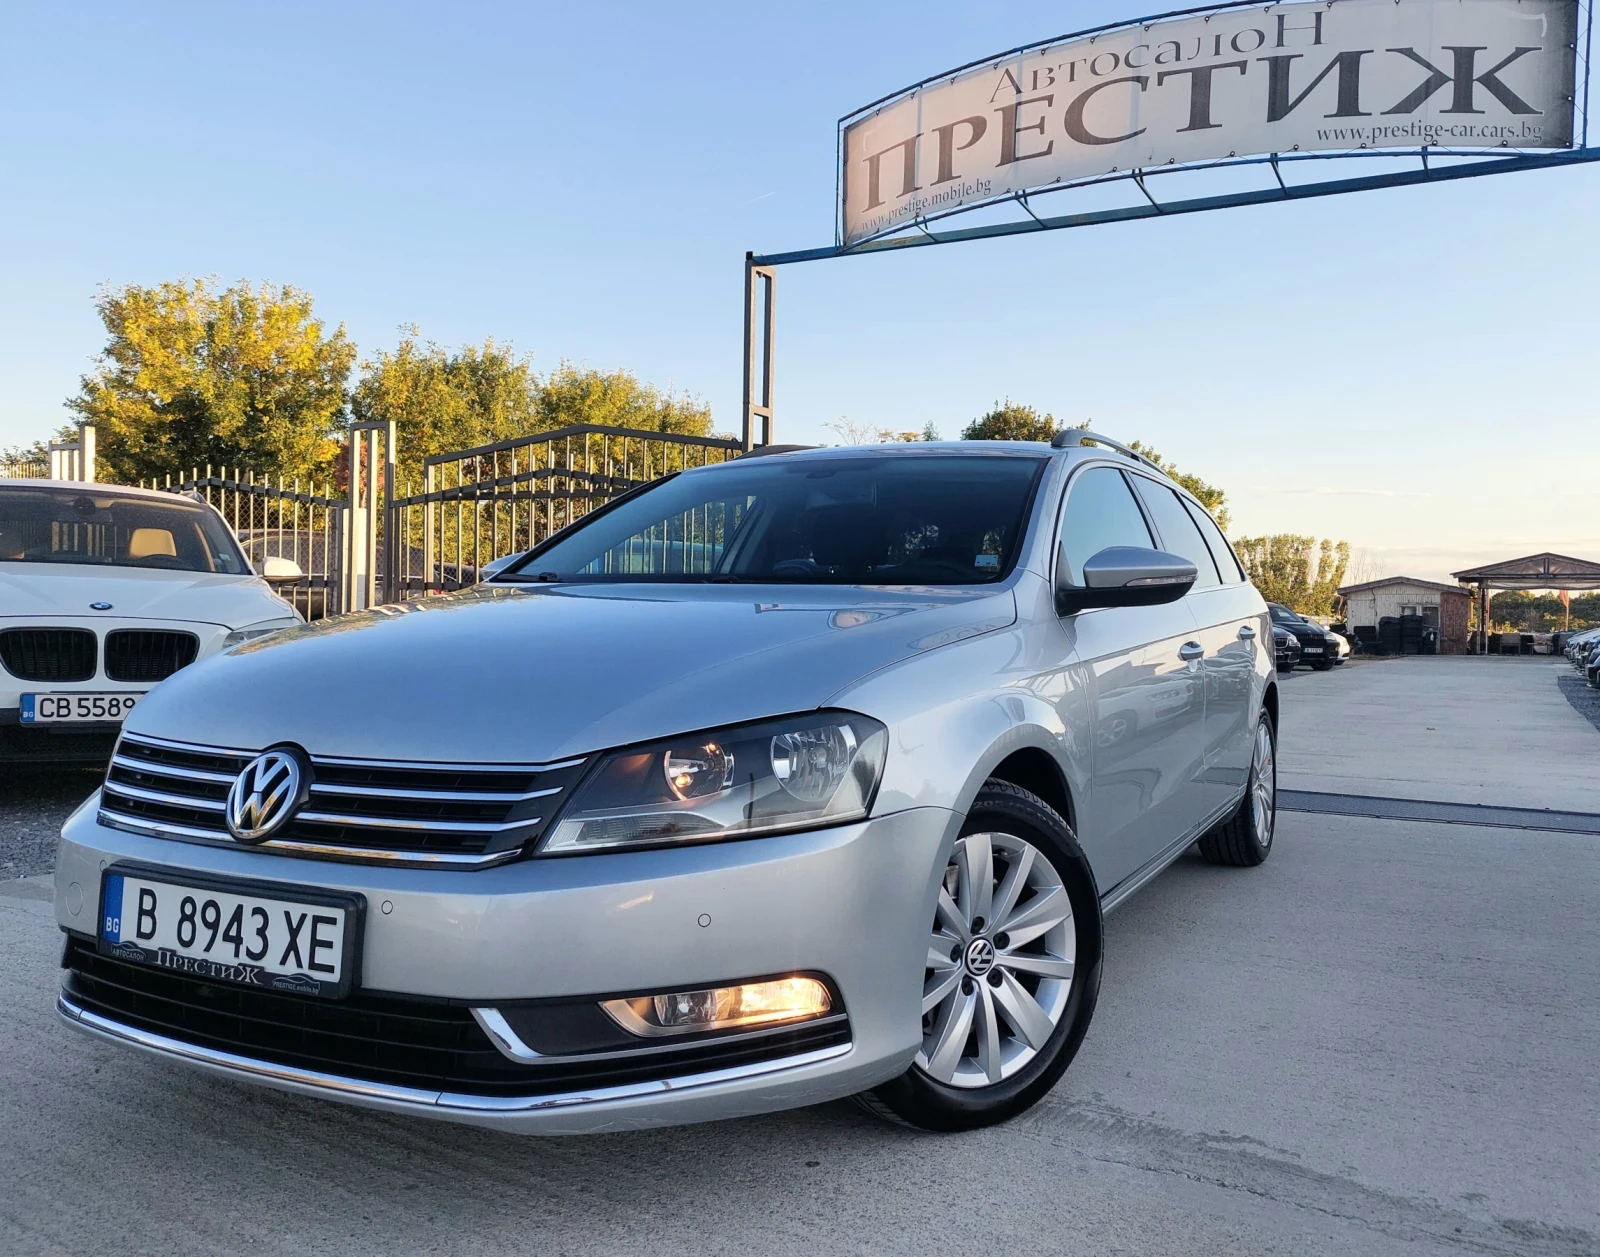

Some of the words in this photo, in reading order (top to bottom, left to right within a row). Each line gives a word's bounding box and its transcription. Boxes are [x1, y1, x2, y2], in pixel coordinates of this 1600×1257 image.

[862, 46, 1544, 214] ПРЕСТИЖ
[1317, 120, 1544, 145] www.prestige-car.cars.bg
[861, 178, 992, 231] www.prestige.mobile.bg
[105, 916, 120, 934] BG
[176, 895, 270, 961] 8943
[279, 910, 338, 974] XE
[112, 948, 144, 961] АВТОСАЛОН
